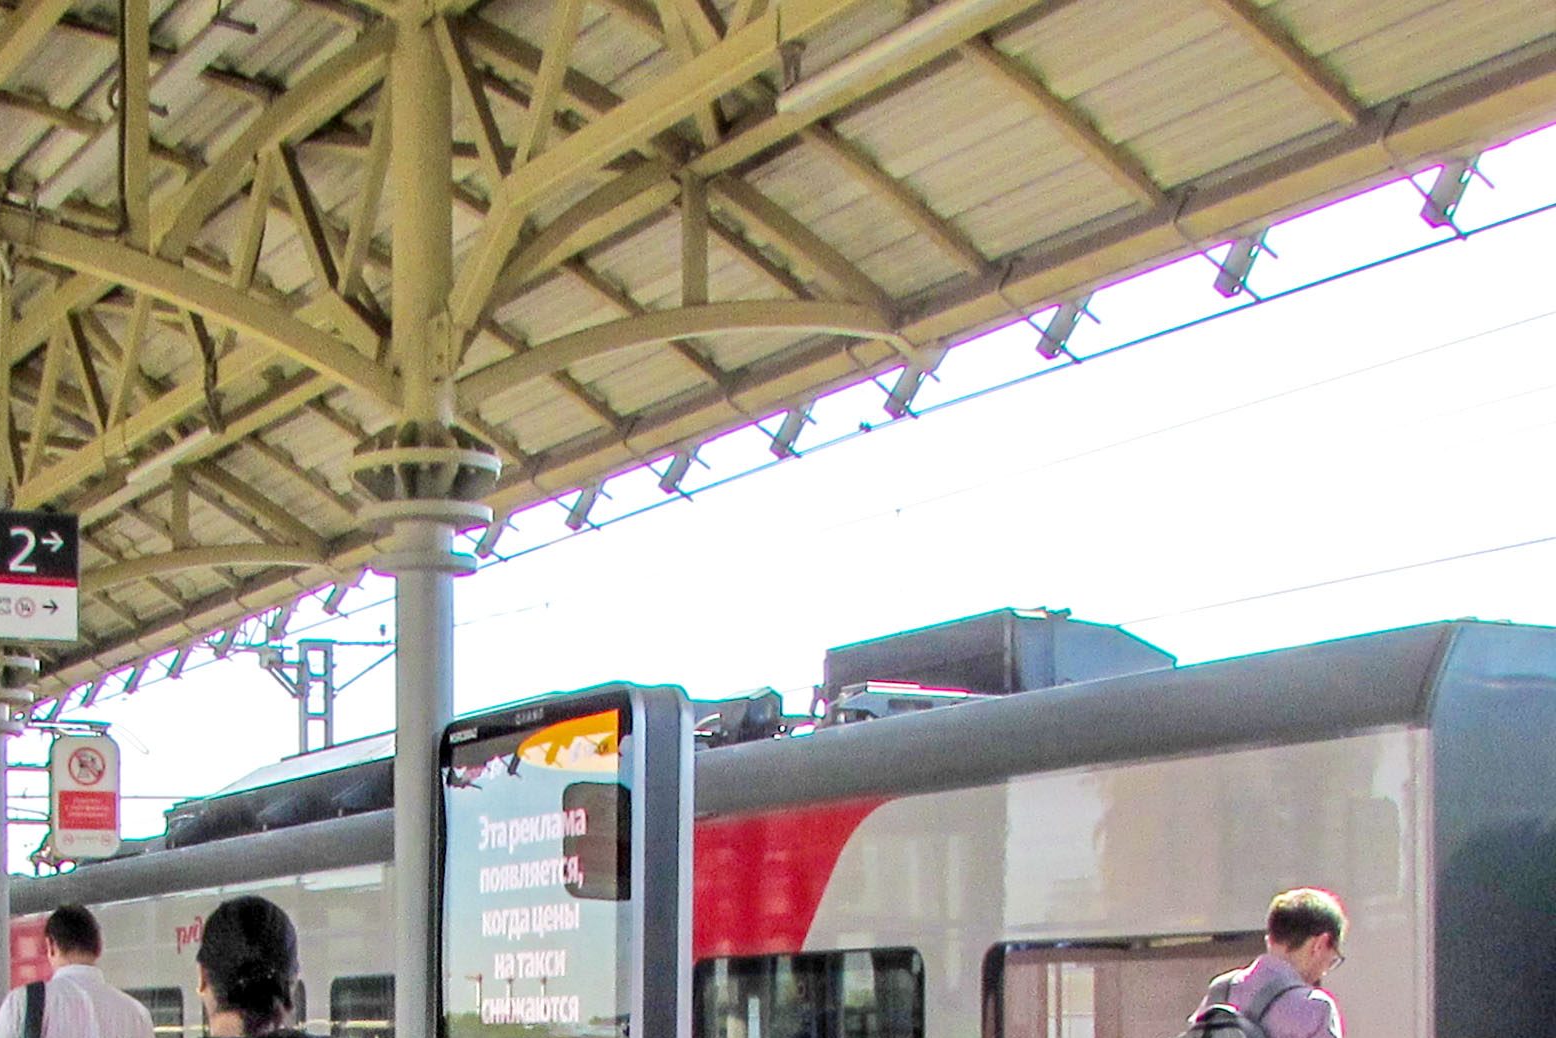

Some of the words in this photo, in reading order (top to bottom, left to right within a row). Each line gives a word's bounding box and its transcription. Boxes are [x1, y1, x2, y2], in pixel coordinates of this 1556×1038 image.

[8, 526, 37, 573] 2
[478, 815, 508, 851] Эта
[508, 808, 586, 854] реклама
[479, 855, 584, 894] появляется,
[482, 908, 530, 941] когда
[531, 902, 580, 938] цены
[494, 953, 514, 980] на
[515, 949, 566, 979] такси
[481, 995, 580, 1025] снижаются
